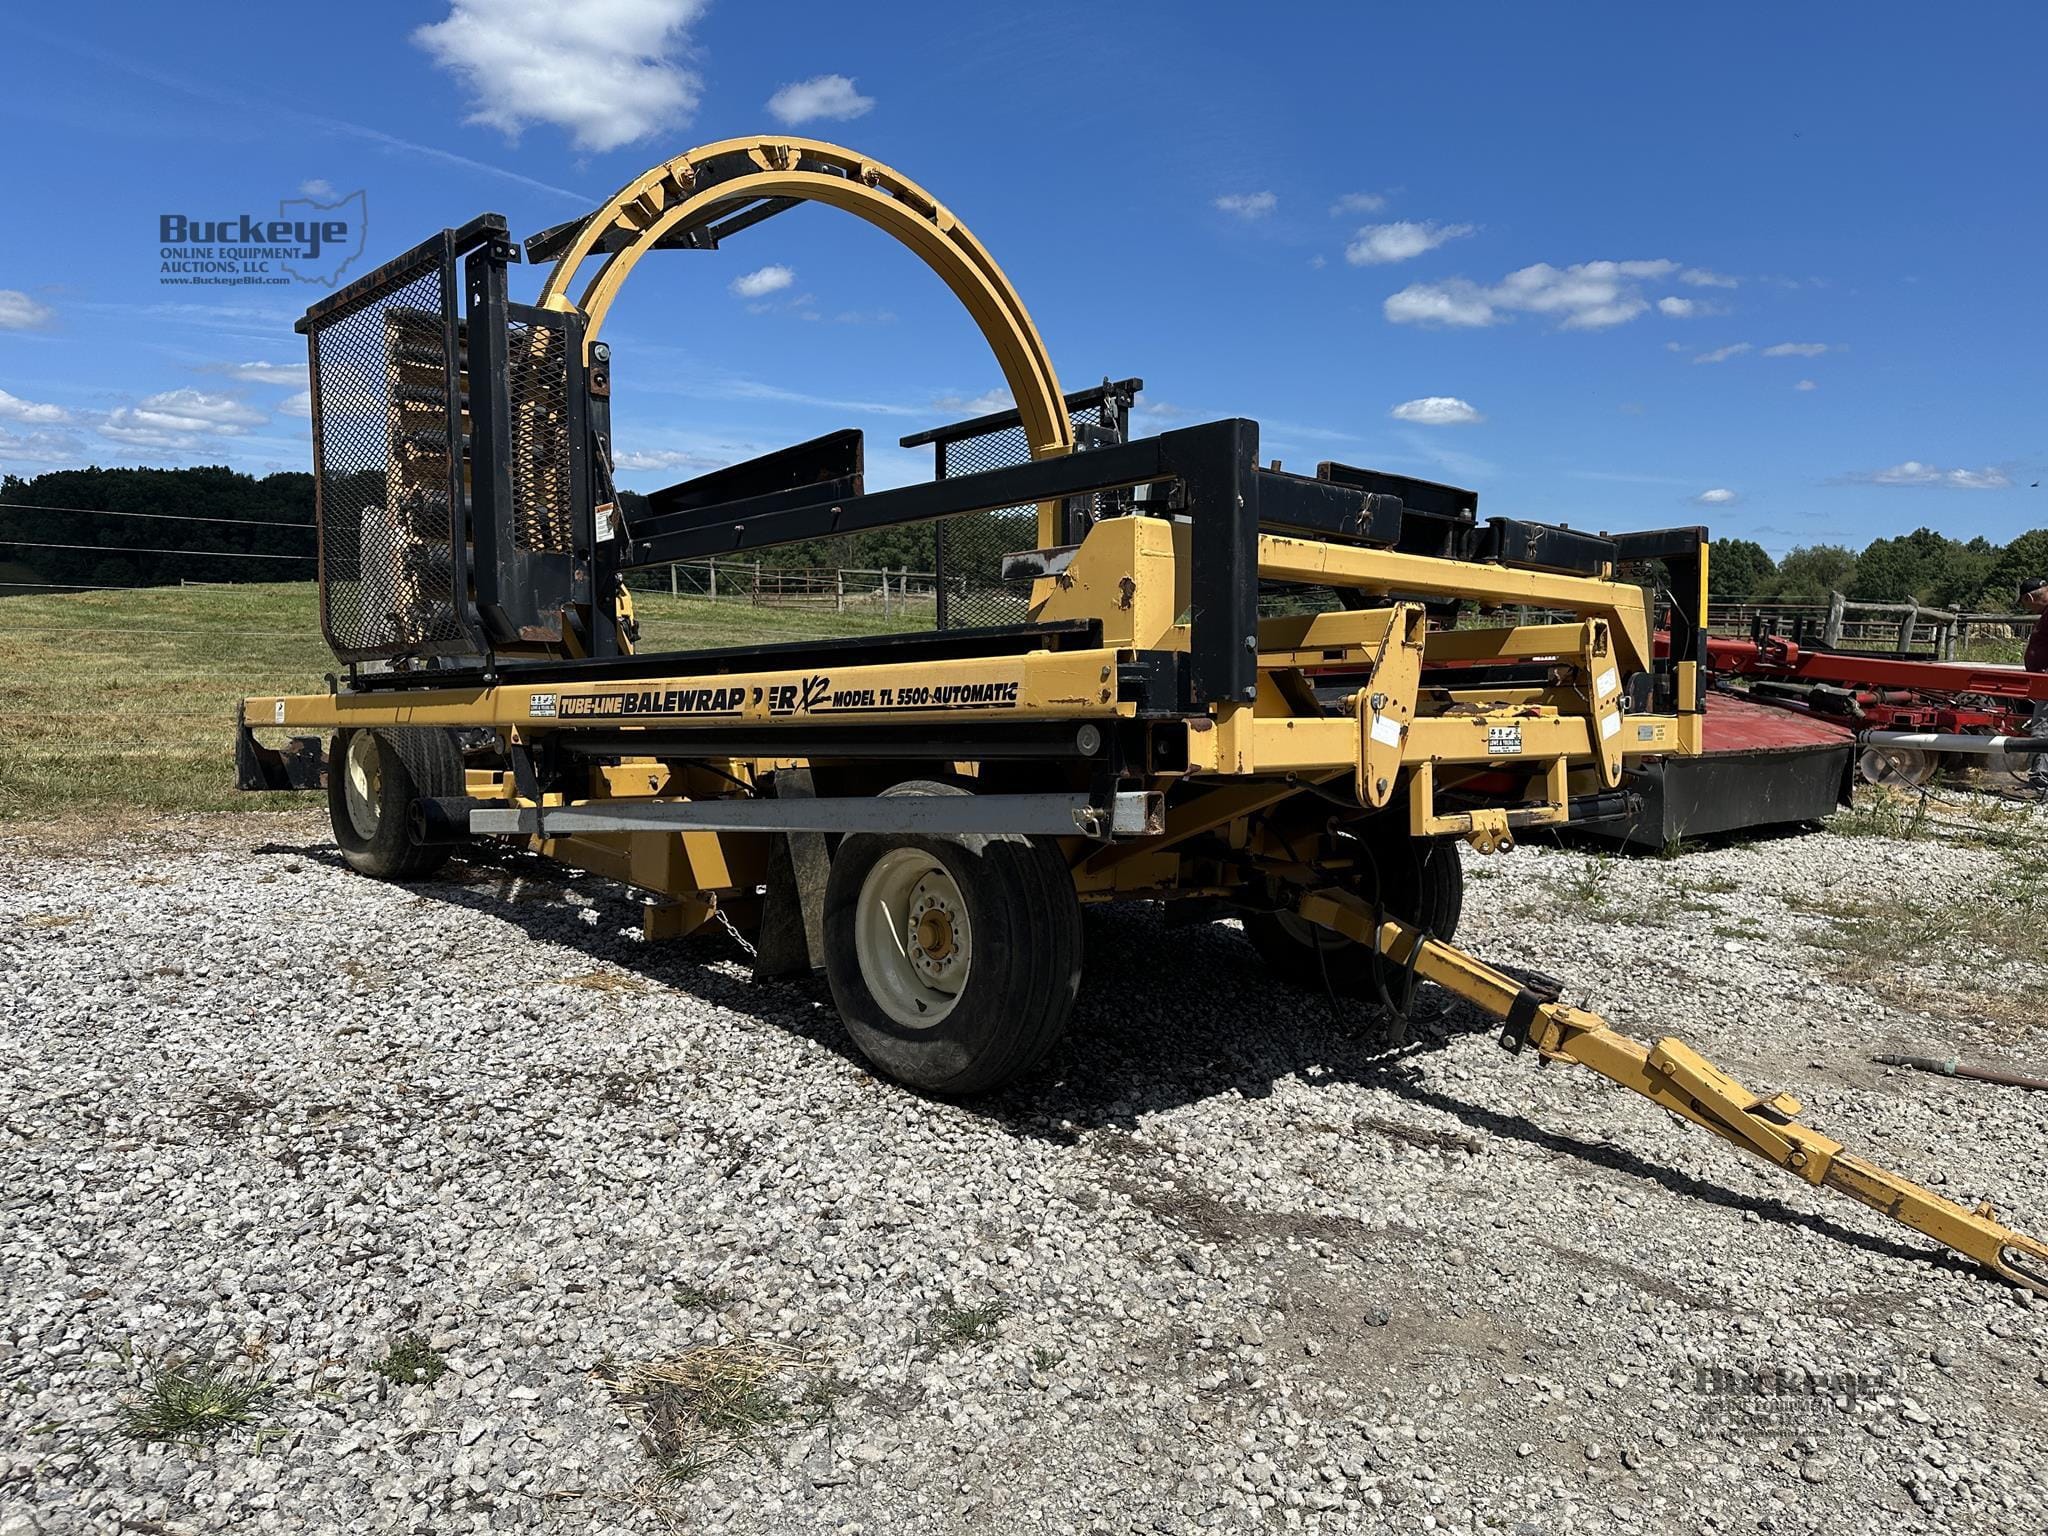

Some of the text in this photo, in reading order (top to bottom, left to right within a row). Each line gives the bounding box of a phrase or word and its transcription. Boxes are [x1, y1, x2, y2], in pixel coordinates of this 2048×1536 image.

[561, 698, 622, 714] TUBE-LINE
[795, 674, 832, 714] X2
[832, 690, 875, 707] MODEL
[879, 689, 893, 706] TL
[897, 687, 929, 706] 5500
[931, 682, 1018, 704] AUTOMATIC
